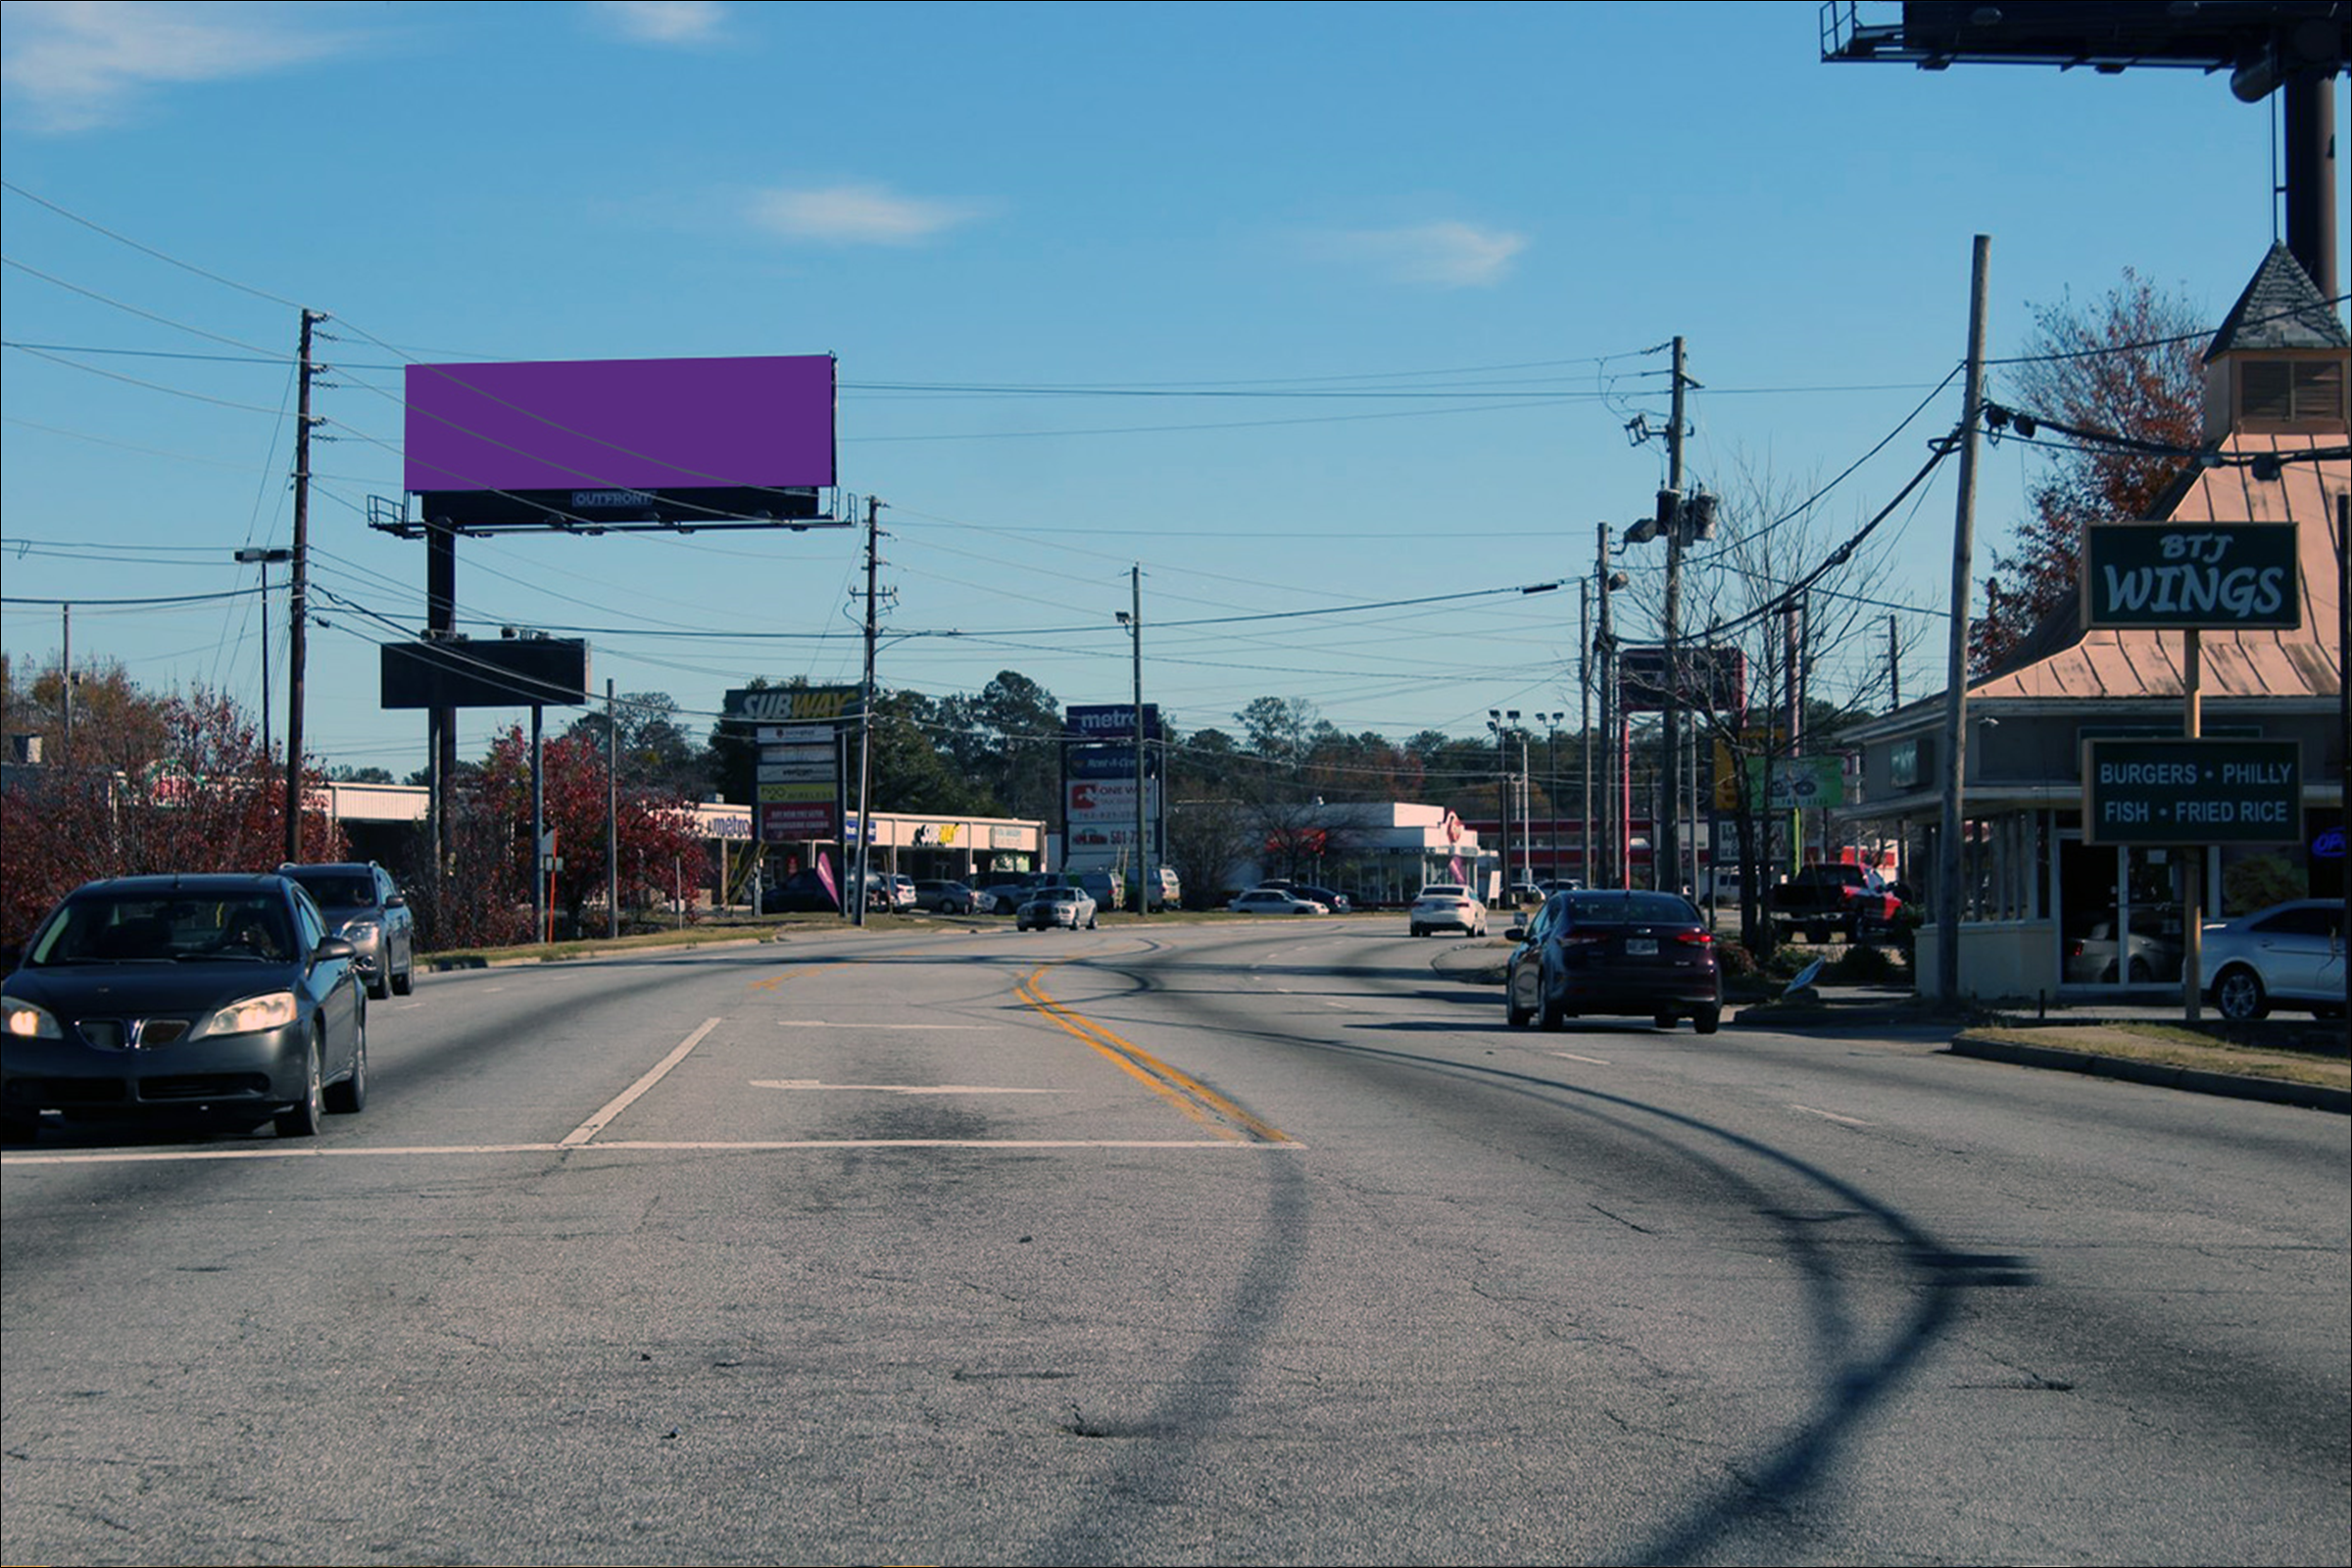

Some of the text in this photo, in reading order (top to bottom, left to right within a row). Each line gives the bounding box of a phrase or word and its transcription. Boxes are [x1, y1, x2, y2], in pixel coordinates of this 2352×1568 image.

[575, 490, 653, 507] OUTFRONT
[2160, 533, 2233, 564] BTJ
[2104, 564, 2284, 617] WINGS
[741, 691, 858, 718] SUBWAY
[2100, 762, 2292, 785] BURGERS PHILLY
[2104, 801, 2288, 823] FISH FRIED RICE
